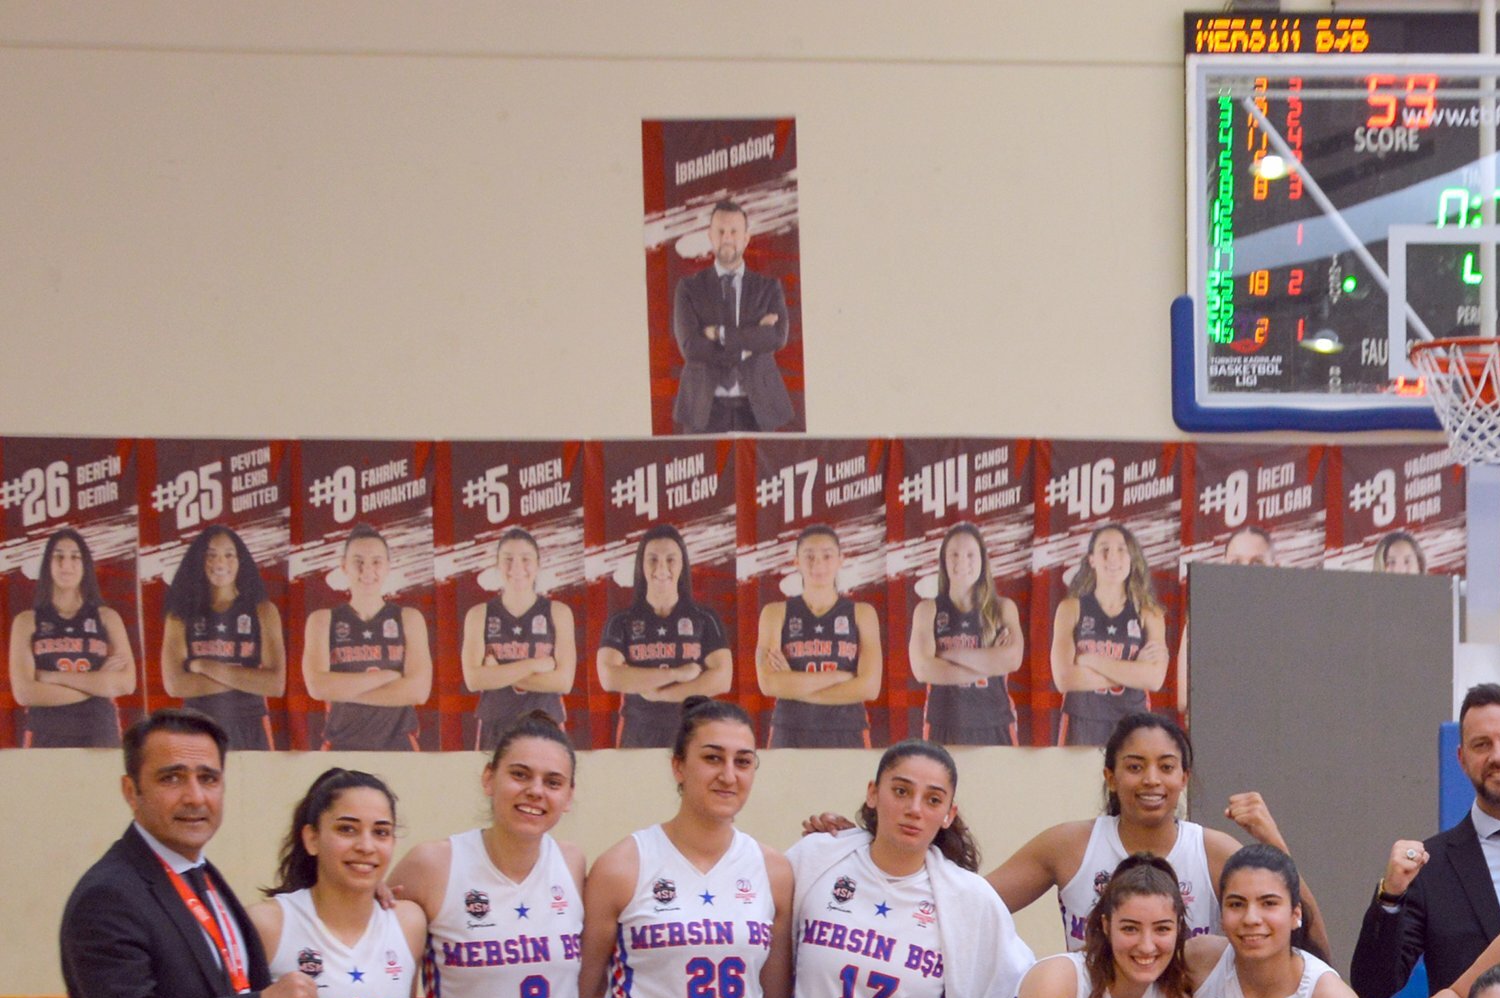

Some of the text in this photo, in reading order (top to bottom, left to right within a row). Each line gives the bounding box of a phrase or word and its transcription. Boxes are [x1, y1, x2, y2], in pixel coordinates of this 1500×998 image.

[1366, 74, 1438, 128] 59
[1354, 126, 1420, 152] SCORE
[675, 161, 728, 186] İBRAHİM
[1209, 364, 1282, 377] BASKETBOL
[77, 455, 121, 485] BERFİN
[230, 447, 271, 473] PEYTON
[361, 459, 408, 489] FAHRİYE
[519, 457, 562, 490] YAREN
[665, 452, 704, 486] NİHAN
[825, 456, 866, 484] İLKNUR
[1123, 458, 1156, 484] NİLAY
[1257, 462, 1295, 493] İREM
[0, 460, 71, 527] #26
[78, 482, 118, 510] DEMİR
[152, 461, 223, 530] #25
[309, 465, 357, 524] #8
[361, 478, 427, 513] BAYRAKTAR
[462, 464, 510, 524] #5
[520, 482, 572, 517] GÜNDÜZ
[611, 462, 658, 521] #4
[756, 458, 818, 524] #17
[898, 453, 968, 519] #44
[1045, 457, 1115, 521] #46
[1200, 469, 1249, 527] #0
[1257, 485, 1312, 520] TULGAR
[1350, 468, 1396, 527] #3
[442, 934, 551, 968] MERSİN
[630, 918, 735, 950] MERSİN
[802, 918, 897, 962] MERSİN
